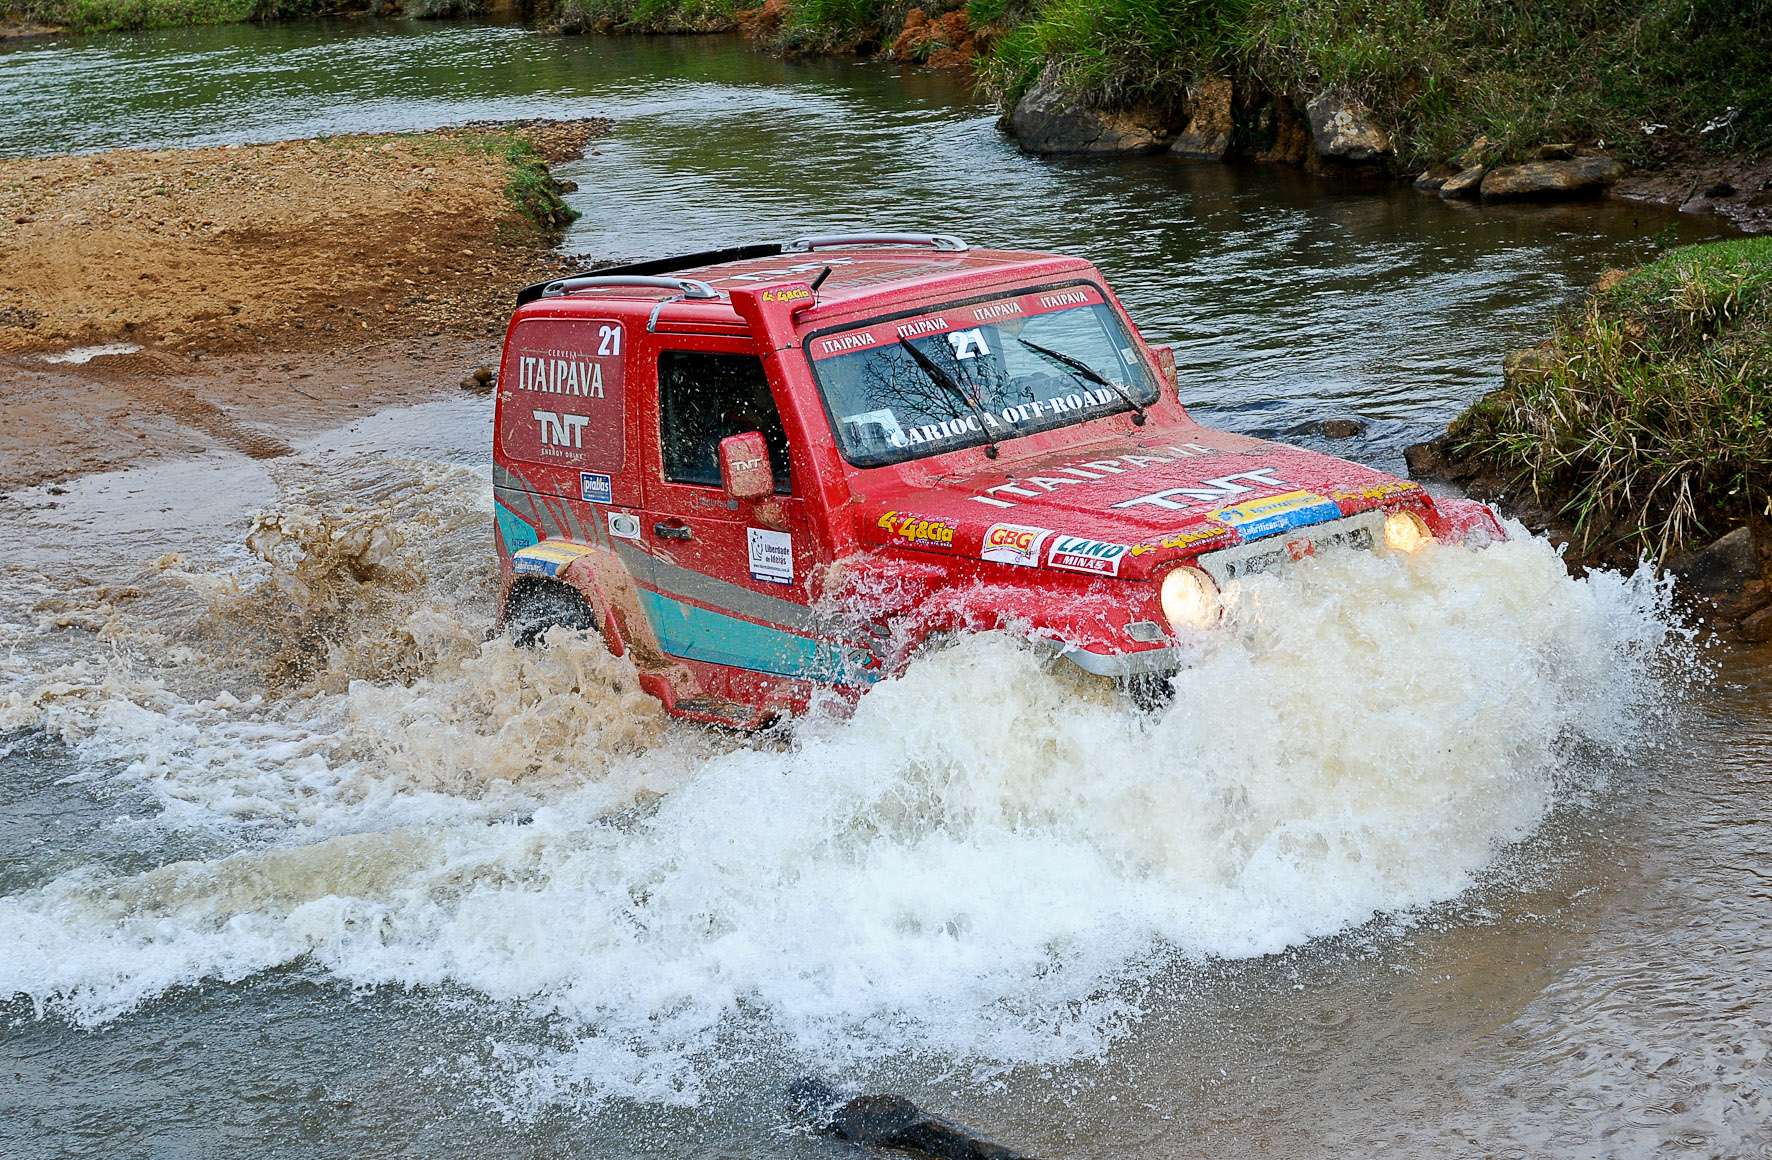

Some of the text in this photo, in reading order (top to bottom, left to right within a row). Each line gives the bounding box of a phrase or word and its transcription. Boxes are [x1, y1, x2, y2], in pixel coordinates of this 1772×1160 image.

[1040, 291, 1089, 309] ITAIPAVA
[973, 302, 1024, 321] ITAIPAVA
[897, 317, 949, 337] ITAIPAVA
[598, 325, 621, 356] 21
[822, 332, 876, 354] ITAIPAVA
[948, 328, 991, 360] 21
[519, 356, 605, 399] ITAIPAVA
[532, 410, 590, 449] TNT
[889, 412, 999, 448] CARIOCA
[732, 458, 760, 471] TNT
[1109, 466, 1287, 510] TNT
[991, 528, 1034, 549] GBG
[1058, 538, 1123, 558] LAND
[1062, 555, 1105, 570] MINAS
